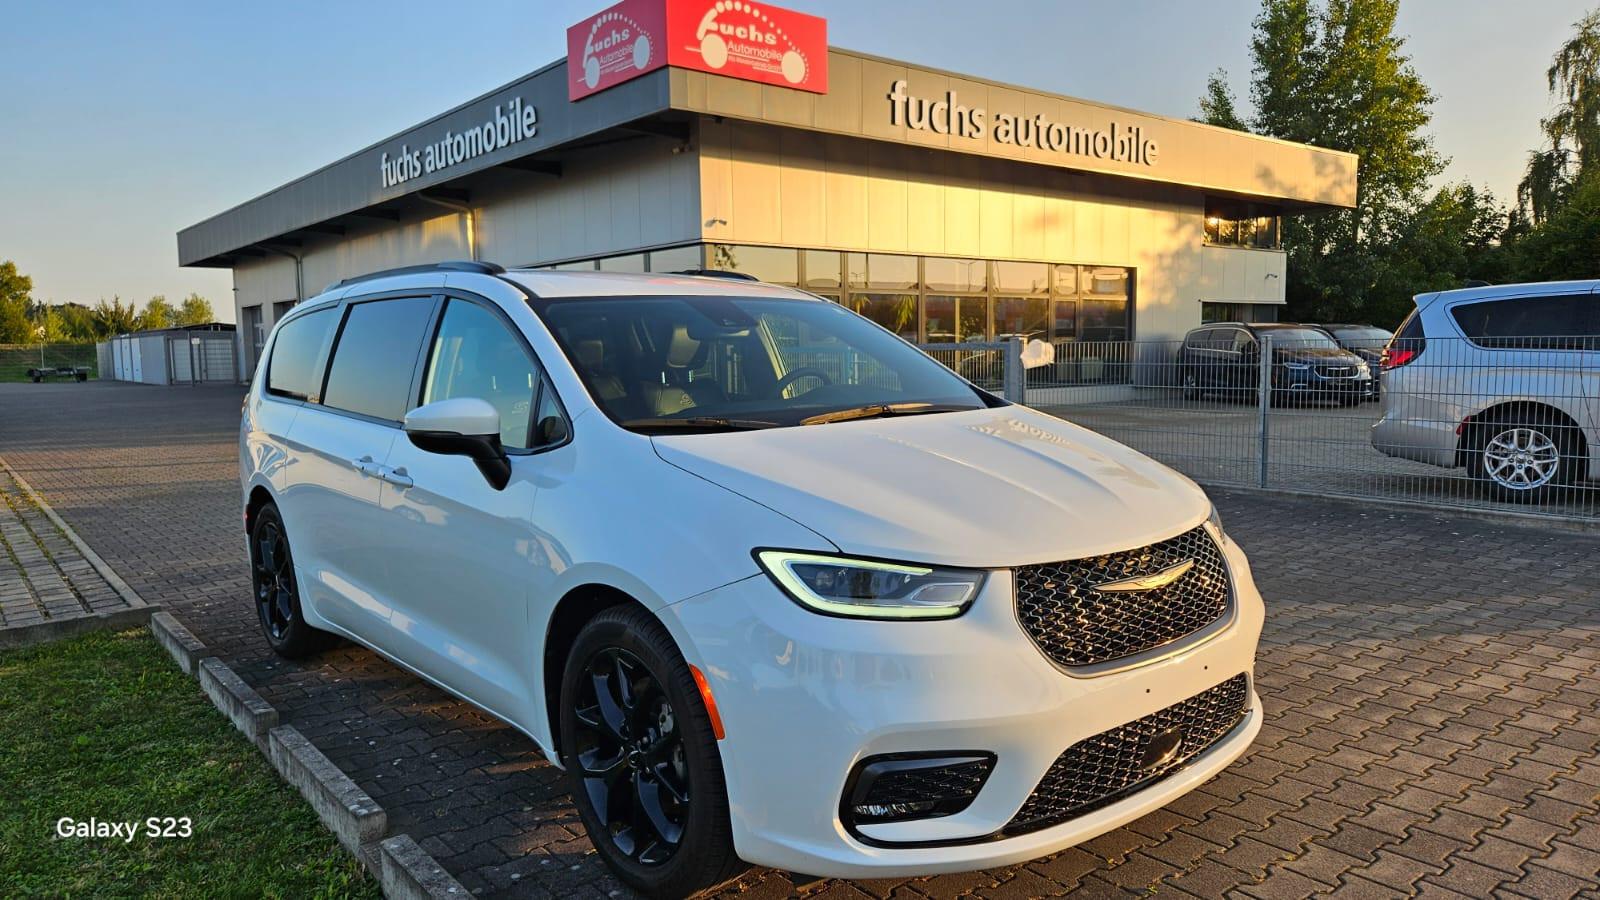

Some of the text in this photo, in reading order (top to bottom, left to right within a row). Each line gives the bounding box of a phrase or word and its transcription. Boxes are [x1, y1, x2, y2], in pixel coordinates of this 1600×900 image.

[381, 97, 537, 188] fuchs automobile
[889, 80, 1160, 166] fuchs automobile
